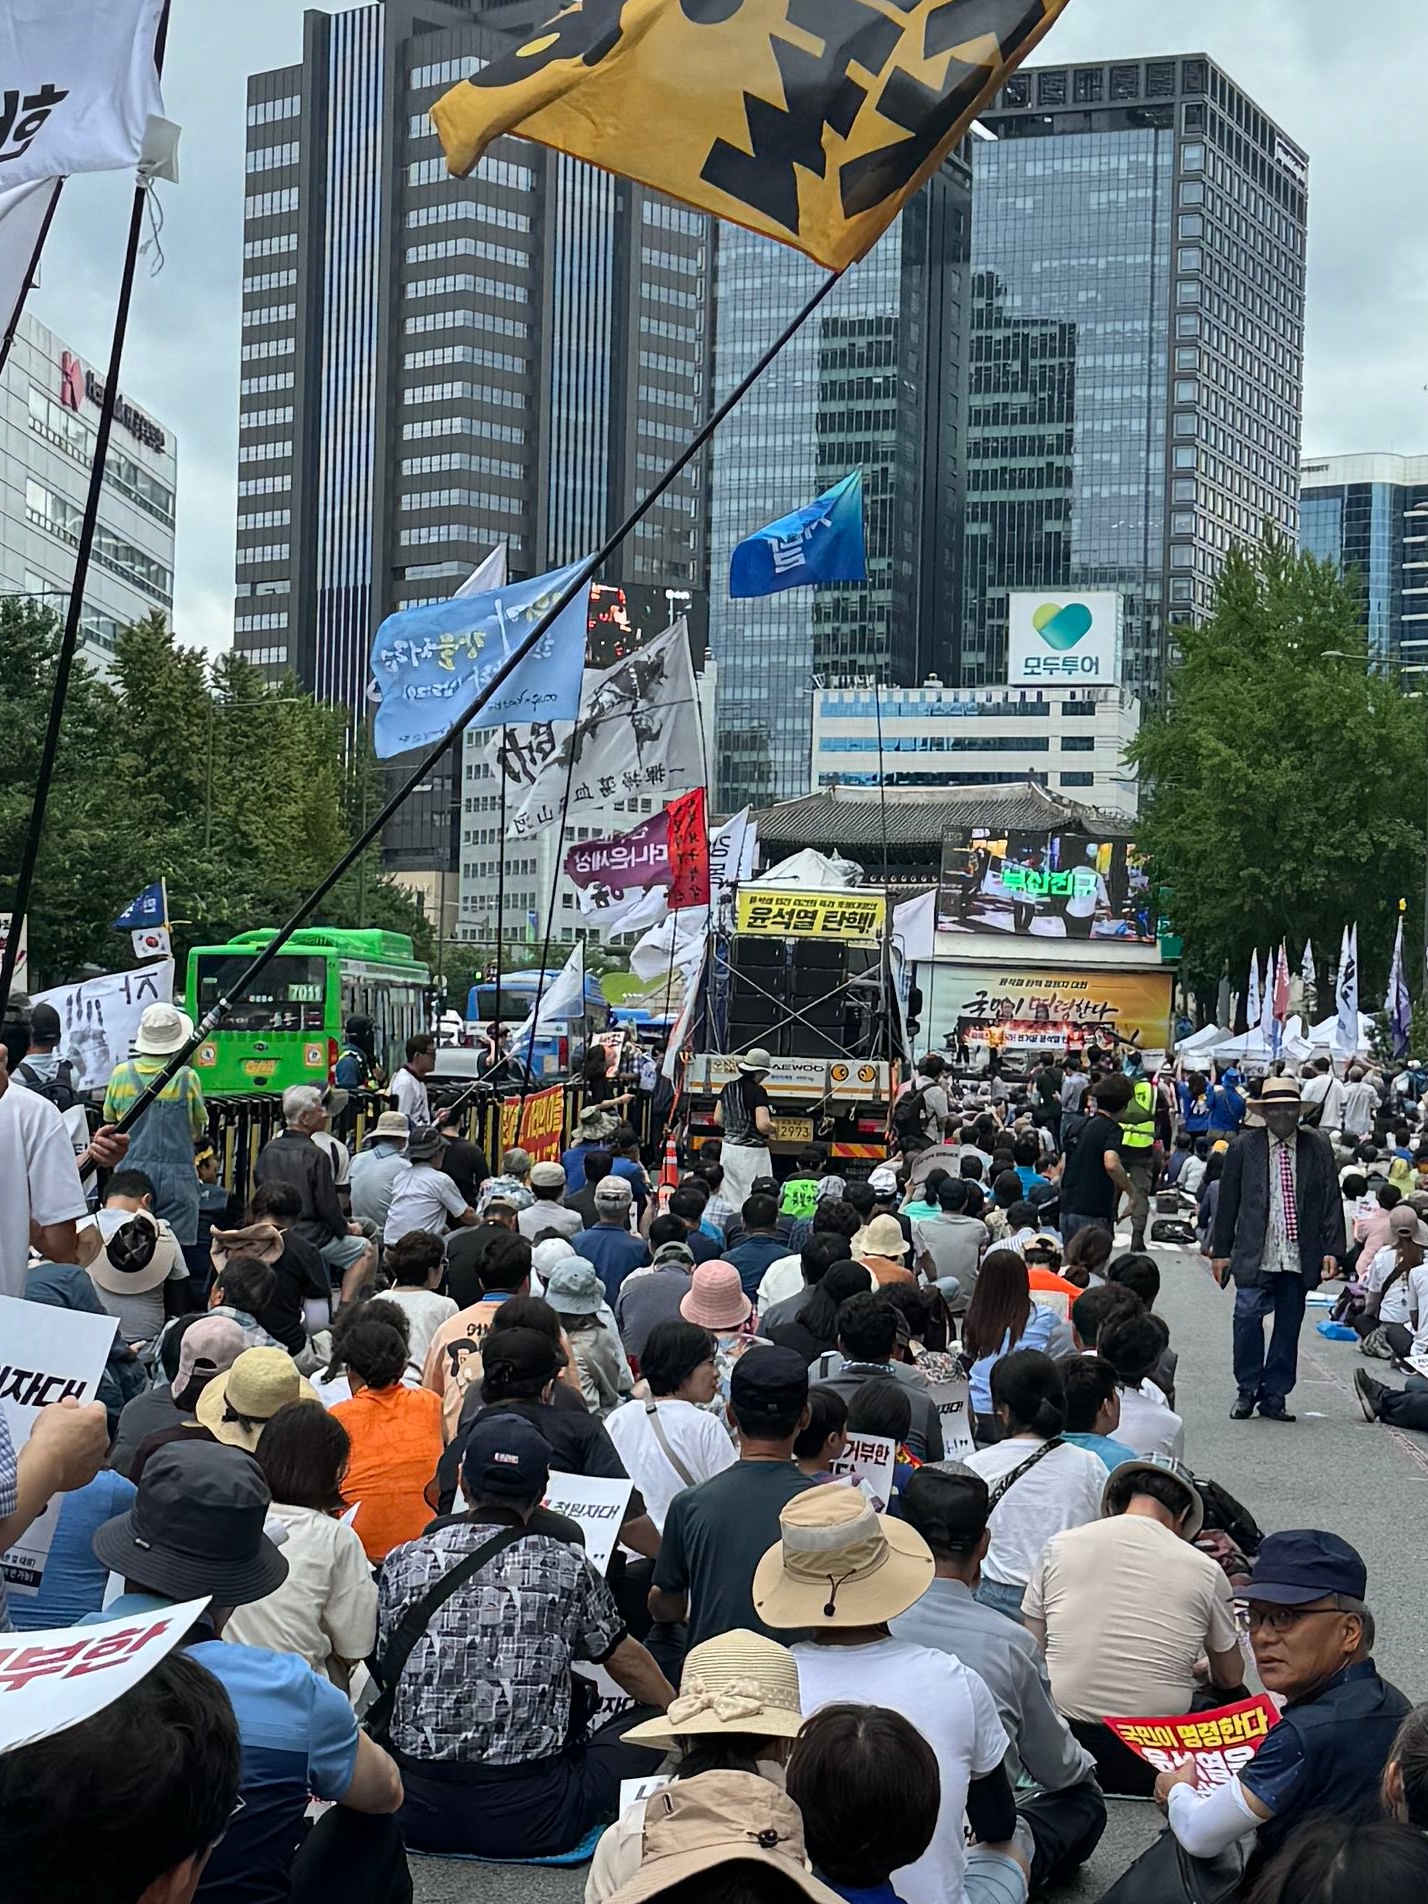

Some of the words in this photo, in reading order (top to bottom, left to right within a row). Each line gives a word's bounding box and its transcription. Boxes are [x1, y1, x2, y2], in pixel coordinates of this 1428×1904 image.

[1023, 656, 1100, 676] 모두투어
[746, 906, 819, 931] 윤석열
[821, 910, 877, 935] 탄핵!
[288, 984, 323, 1002] 7011
[771, 1063, 825, 1073] AEWOO
[780, 1126, 810, 1138] 2973
[1117, 1723, 1180, 1749] 국민이
[1176, 1706, 1269, 1749] 명령한다
